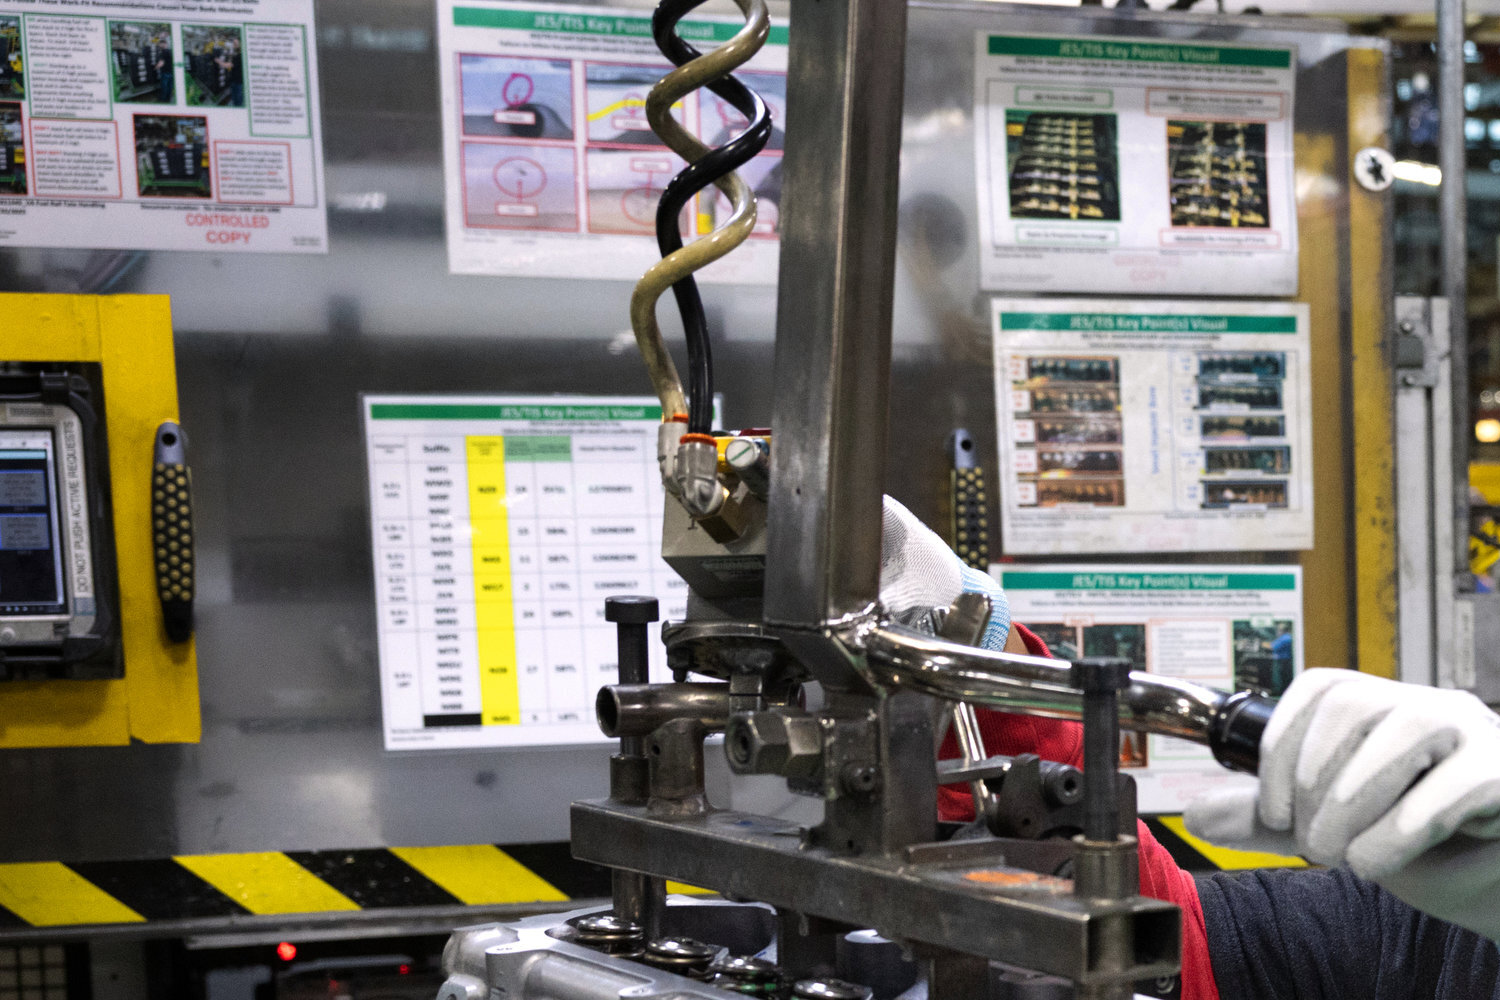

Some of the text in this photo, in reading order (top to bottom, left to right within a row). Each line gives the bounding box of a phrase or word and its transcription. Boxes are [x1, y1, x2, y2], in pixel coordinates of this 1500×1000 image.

[587, 20, 612, 35] Key
[1107, 46, 1131, 61] Key
[185, 212, 270, 229] CONTROLLED
[206, 230, 251, 244] COPY
[1117, 316, 1141, 332] Key
[542, 407, 563, 421] Key
[1117, 574, 1141, 590] Key
